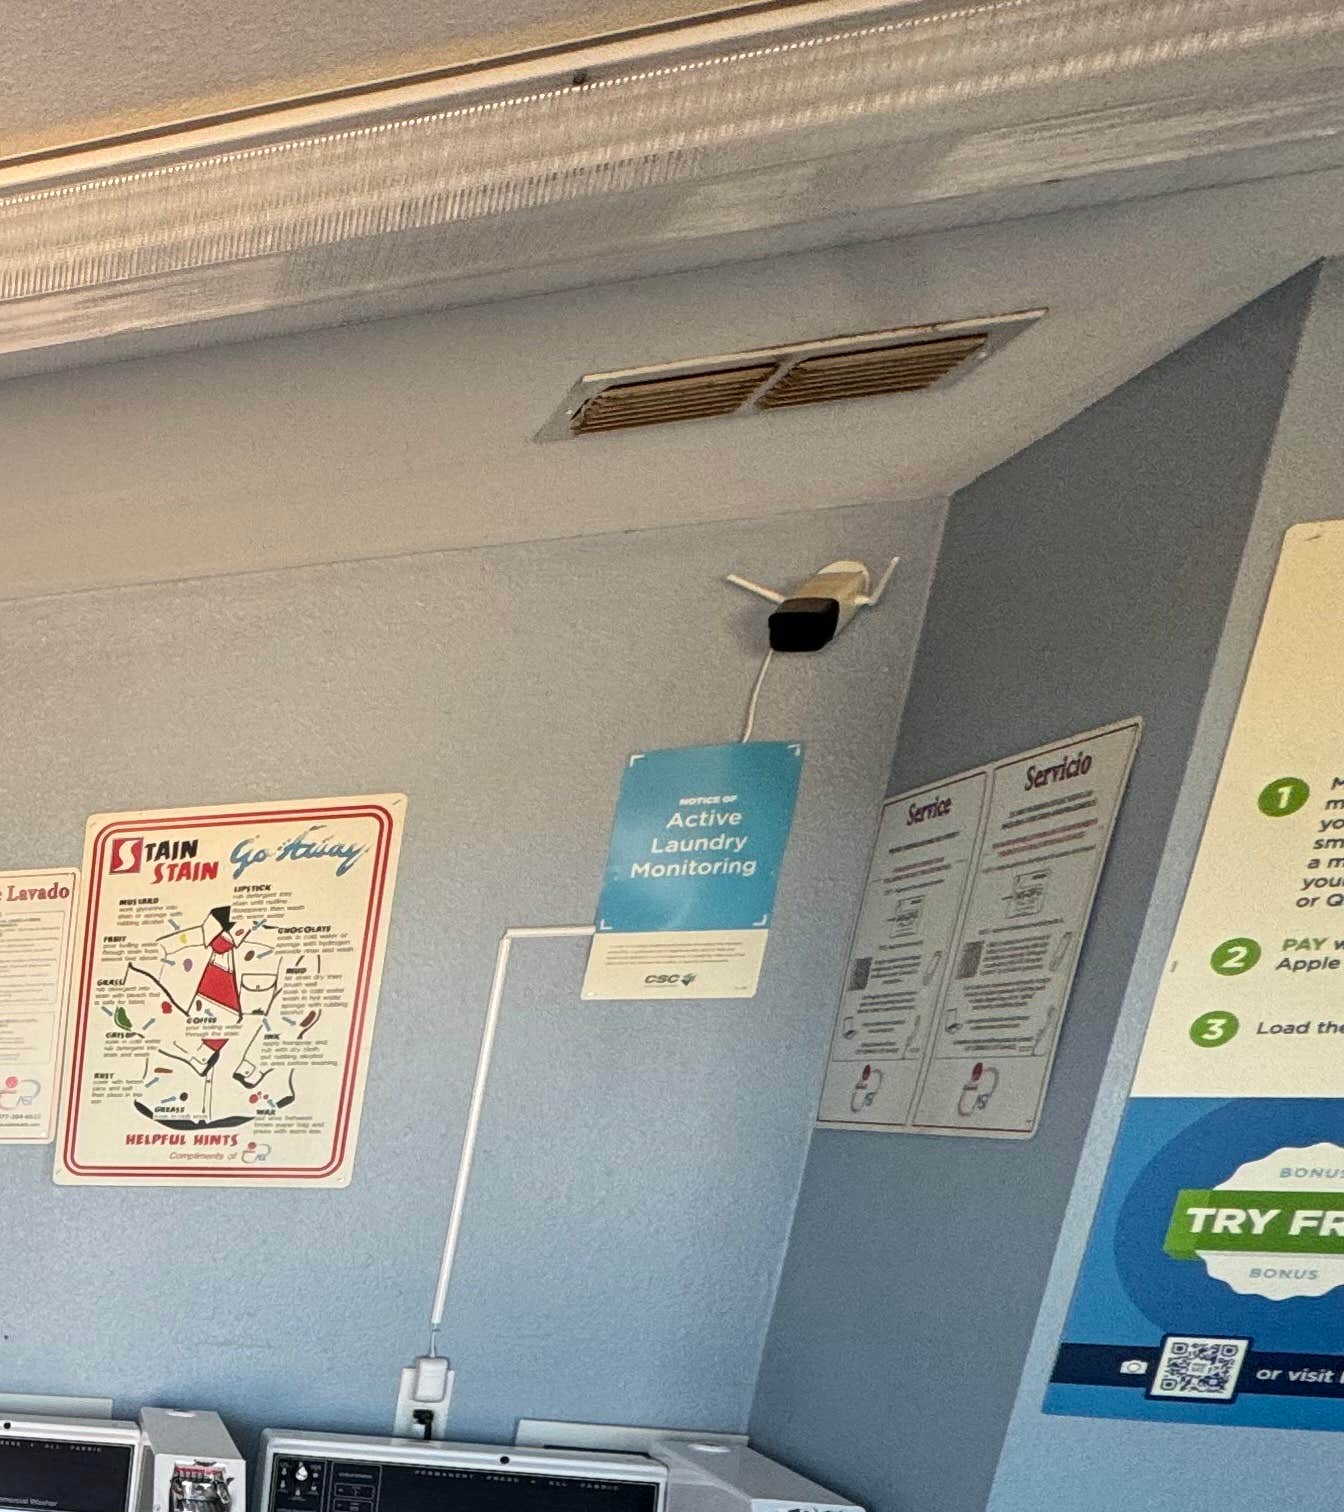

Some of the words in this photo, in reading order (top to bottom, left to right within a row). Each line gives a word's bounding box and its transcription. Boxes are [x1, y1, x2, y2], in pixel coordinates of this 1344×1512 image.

[1025, 752, 1093, 791] Servicio
[679, 796, 720, 806] NOTICE
[723, 795, 737, 804] OF
[1278, 786, 1293, 809] 1
[666, 811, 742, 828] Active
[906, 797, 952, 826] Service
[650, 834, 748, 853] Laundry
[230, 836, 268, 879] Go
[275, 826, 368, 876] Away
[630, 859, 757, 878] Monitoring
[1307, 859, 1320, 869] a
[151, 861, 219, 884] STAIN
[7, 882, 70, 902] Lavado
[233, 884, 272, 893] LIPSTICK
[119, 897, 159, 905] MUSTARD
[1296, 897, 1320, 907] or
[277, 925, 332, 934] CHOCOLATE
[1224, 946, 1248, 967] 2
[1281, 937, 1329, 951] PAY
[1275, 957, 1341, 973] Apple
[644, 975, 680, 984] CSC
[1203, 1019, 1224, 1040] 3
[1256, 1021, 1312, 1035] Load
[125, 1133, 187, 1146] HELPFUL
[193, 1133, 240, 1147] HINTS
[169, 1151, 224, 1161] Compliments
[227, 1151, 238, 1160] of
[1186, 1207, 1281, 1235] TRY
[1249, 1268, 1319, 1280] BONUS
[1256, 1369, 1279, 1381] or
[1288, 1368, 1335, 1383] visit
